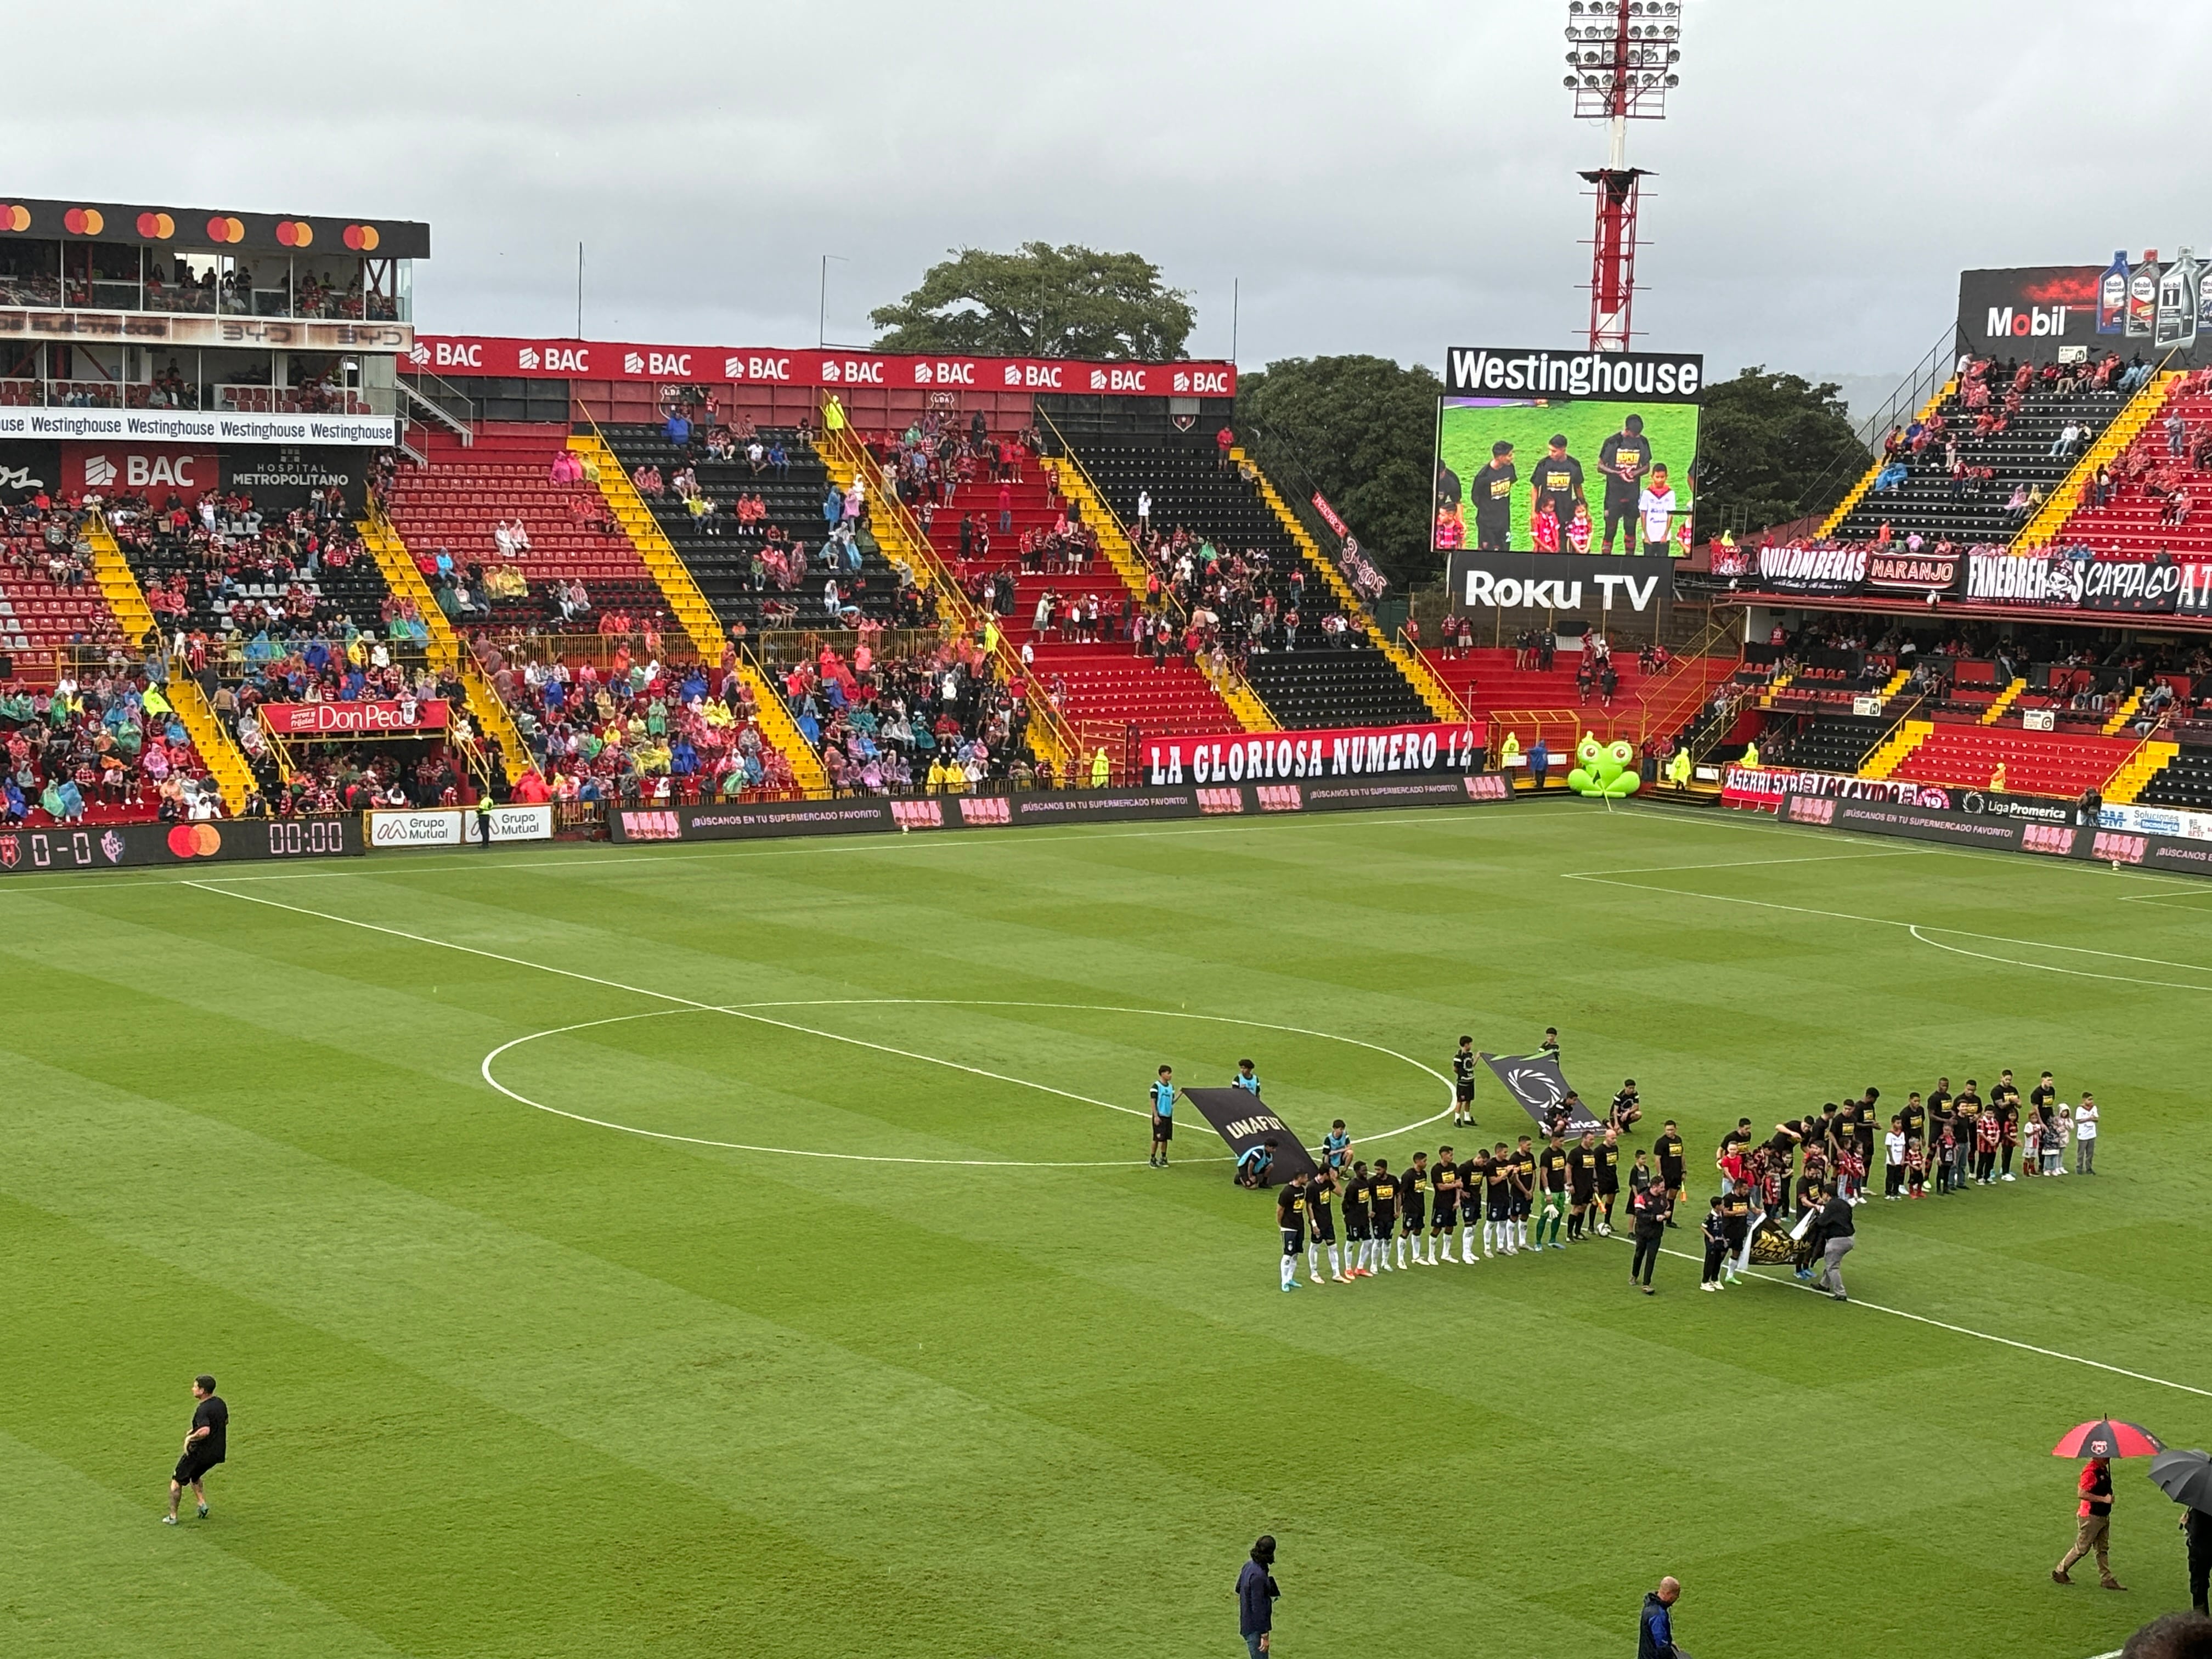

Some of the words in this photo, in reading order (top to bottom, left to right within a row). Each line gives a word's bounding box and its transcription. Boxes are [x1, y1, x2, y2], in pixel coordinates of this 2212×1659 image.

[1987, 306, 2066, 336] Mobil
[436, 343, 482, 367] BAC
[545, 348, 589, 371] BAC
[649, 353, 691, 376] BAC
[749, 357, 790, 380] BAC
[845, 361, 884, 383] BAC
[936, 363, 975, 385] BAC
[1025, 366, 1062, 388] BAC
[1452, 350, 1699, 395] Westinghouse
[1110, 370, 1146, 391] BAC
[1193, 372, 1228, 392] BAC
[0, 419, 24, 431] use
[31, 416, 121, 436] Westinghouse
[127, 417, 215, 438] Westinghouse
[220, 420, 305, 440] Westinghouse
[311, 422, 393, 442] Westinghouse
[127, 455, 195, 487] BAC
[233, 473, 348, 486] METROPOLITANO
[257, 464, 327, 473] HOSPITAL
[1342, 536, 1358, 563] 3
[1871, 560, 1954, 583] NARANJO
[2085, 562, 2180, 600] CARTAGO
[1465, 570, 1582, 610] Roku
[1594, 574, 1659, 611] TV
[319, 706, 362, 729] Don
[1150, 745, 1183, 785] LA
[1193, 738, 1323, 784] GLORIOSA
[1332, 731, 1437, 775] NUMERO
[1446, 730, 1474, 767] 12
[1360, 788, 1369, 796] TU
[1370, 785, 1423, 795] SUPERMERCADO
[1424, 784, 1458, 793] FAVORITO!
[1066, 801, 1076, 809] EN
[1077, 800, 1087, 809] TU
[1088, 798, 1149, 809] SUPERMERCADO
[1150, 797, 1188, 806] FAVORITO!
[1988, 800, 2009, 815] Liga
[2009, 803, 2066, 820] Promerica
[410, 818, 445, 830] Grupo
[501, 813, 536, 825] Grupo
[743, 815, 755, 824] EN
[757, 815, 768, 823] TU
[768, 811, 838, 823] SUPERMERCADO
[839, 809, 882, 820] FAVORITO!
[1842, 808, 1886, 821] ¡BÚSCANOS
[1886, 815, 1897, 823] EN
[1898, 816, 1908, 824] TU
[1909, 816, 1971, 832] SUPERMERCADO
[1972, 823, 2013, 838] FAVORITO!
[2134, 810, 2179, 822] Soluciones
[269, 822, 343, 855] 00:00
[409, 828, 448, 839] Mutual
[501, 823, 539, 836] Mutual
[2155, 847, 2207, 861] ¡BÚSCANOS
[1226, 1115, 1288, 1139] UNAFUT
